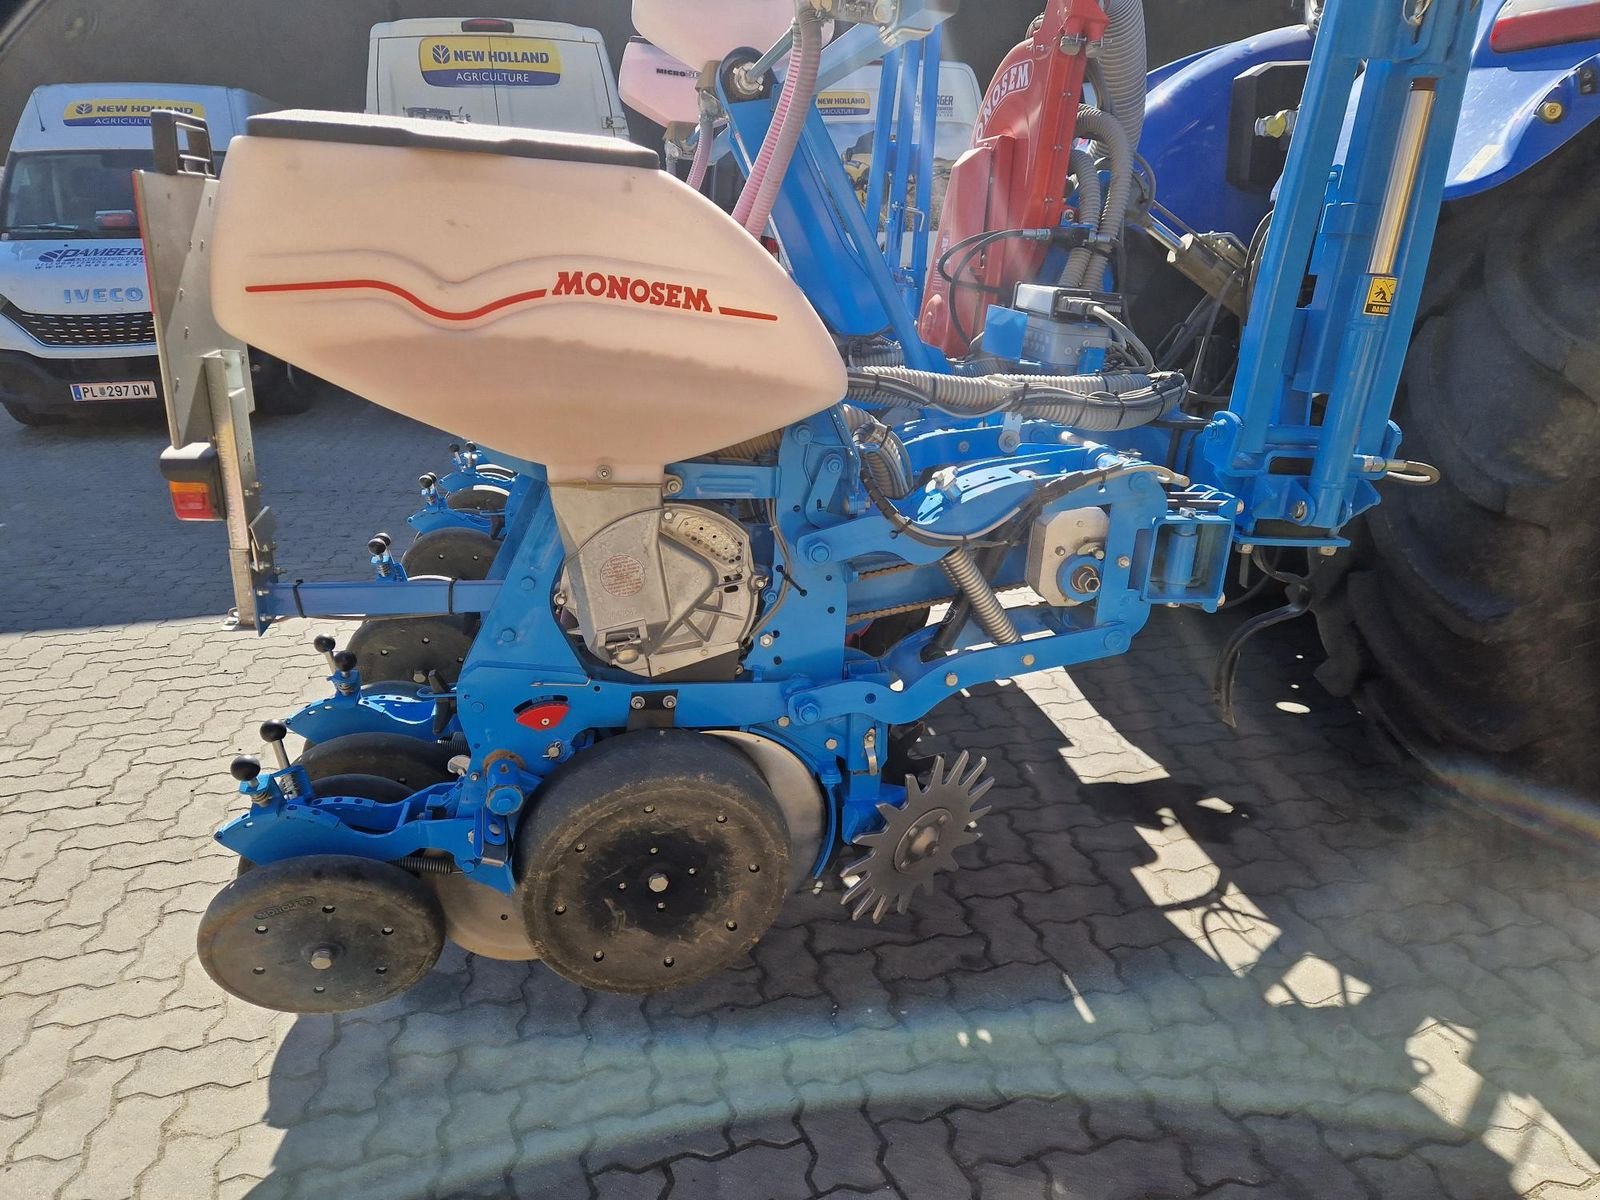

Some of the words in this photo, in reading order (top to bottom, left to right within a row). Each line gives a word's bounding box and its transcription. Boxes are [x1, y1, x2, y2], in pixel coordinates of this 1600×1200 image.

[454, 50, 484, 62] NEW
[488, 51, 549, 64] HOLLAND
[456, 72, 529, 82] AGRICULTURE
[818, 97, 833, 105] NEW
[834, 97, 865, 105] HOLLAND
[976, 63, 1029, 140] ONOSEM
[97, 105, 127, 113] NEW
[64, 287, 143, 304] IVECO
[552, 271, 713, 313] MONOSEM
[82, 386, 97, 398] PL
[106, 385, 129, 397] 297
[132, 384, 150, 396] DW
